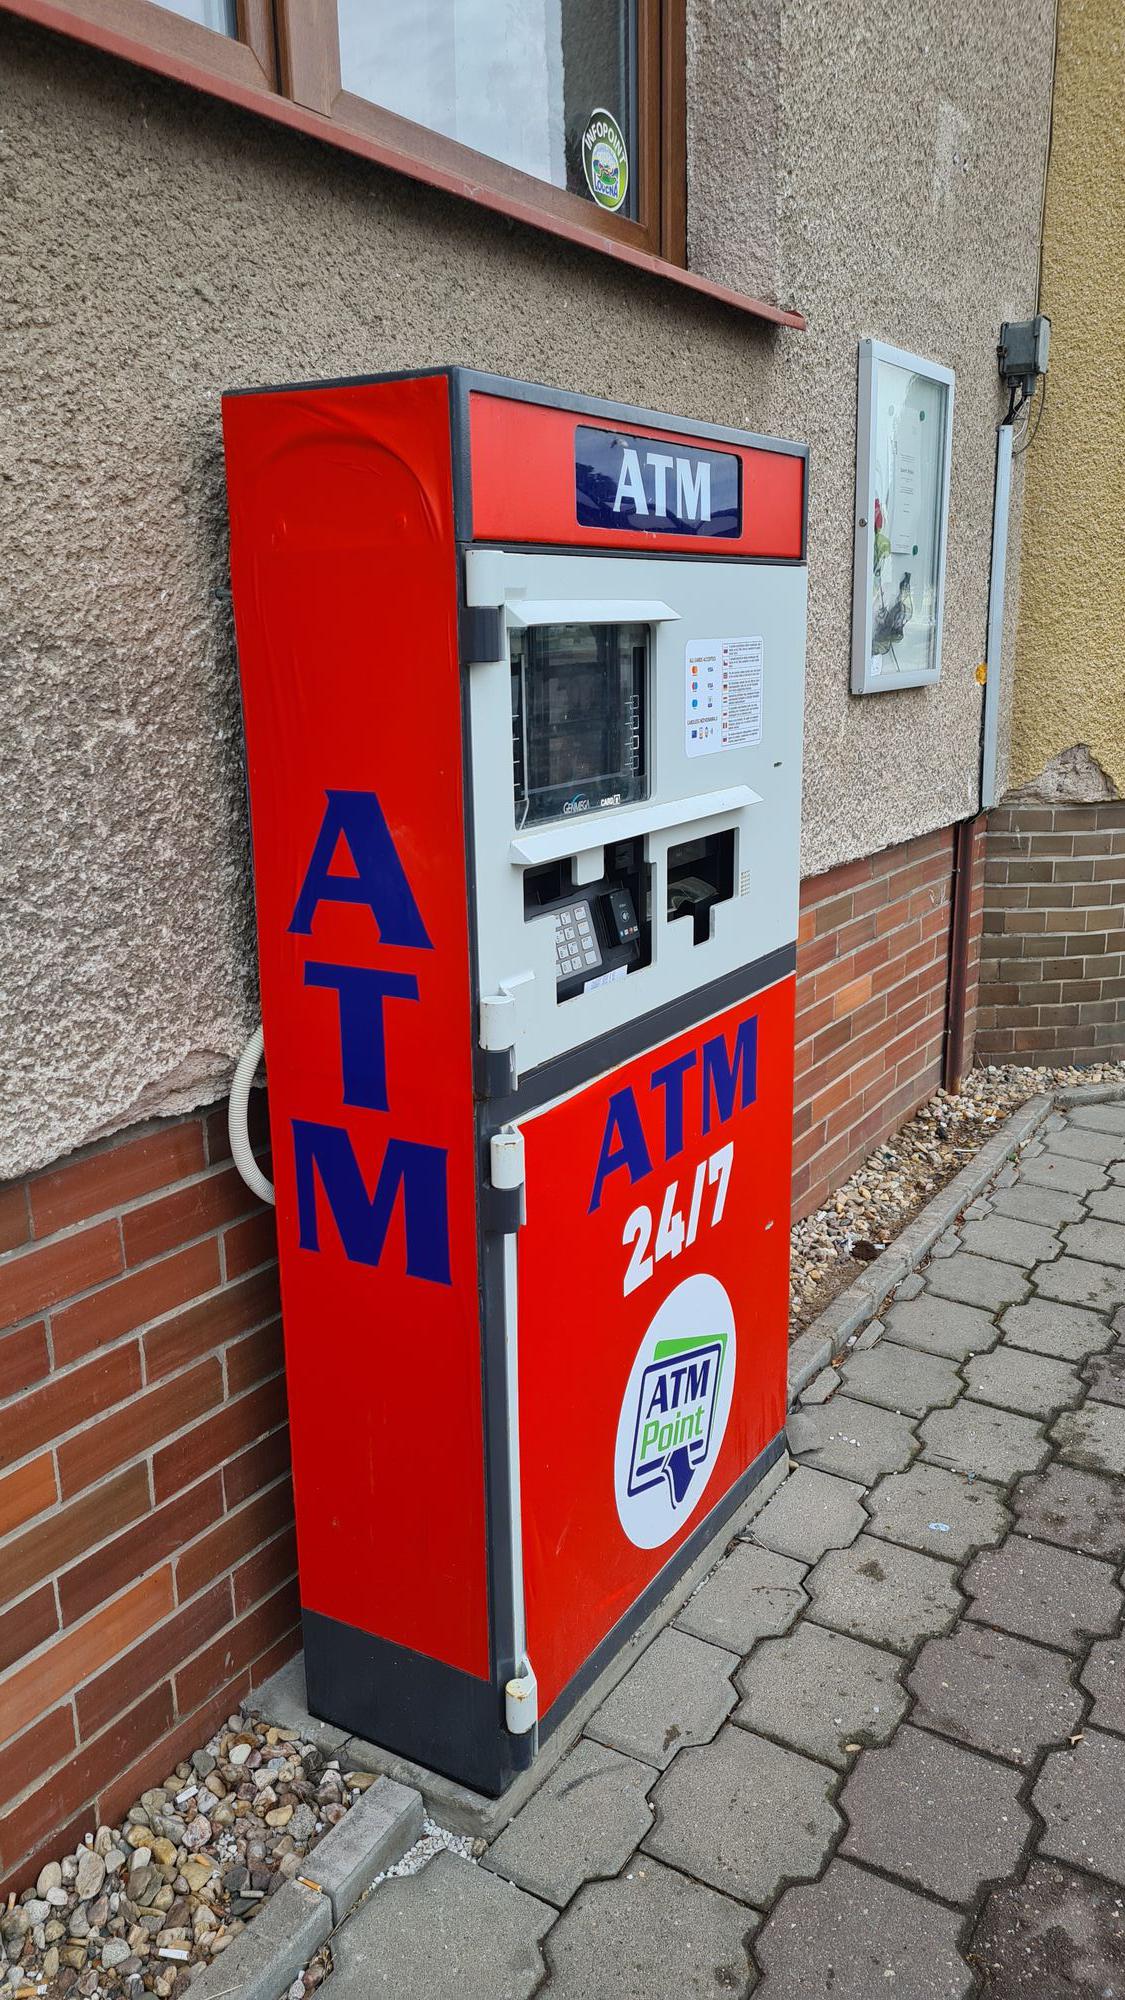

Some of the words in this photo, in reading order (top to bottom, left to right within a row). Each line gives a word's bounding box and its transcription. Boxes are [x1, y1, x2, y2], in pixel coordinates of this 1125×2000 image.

[585, 121, 627, 163] INFOPOINT
[612, 448, 712, 522] ATM
[286, 788, 453, 1286] ATM
[587, 1014, 759, 1214] ATM
[622, 1141, 735, 1298] 24/7
[646, 1358, 712, 1420] ATM
[639, 1404, 705, 1461] Point
